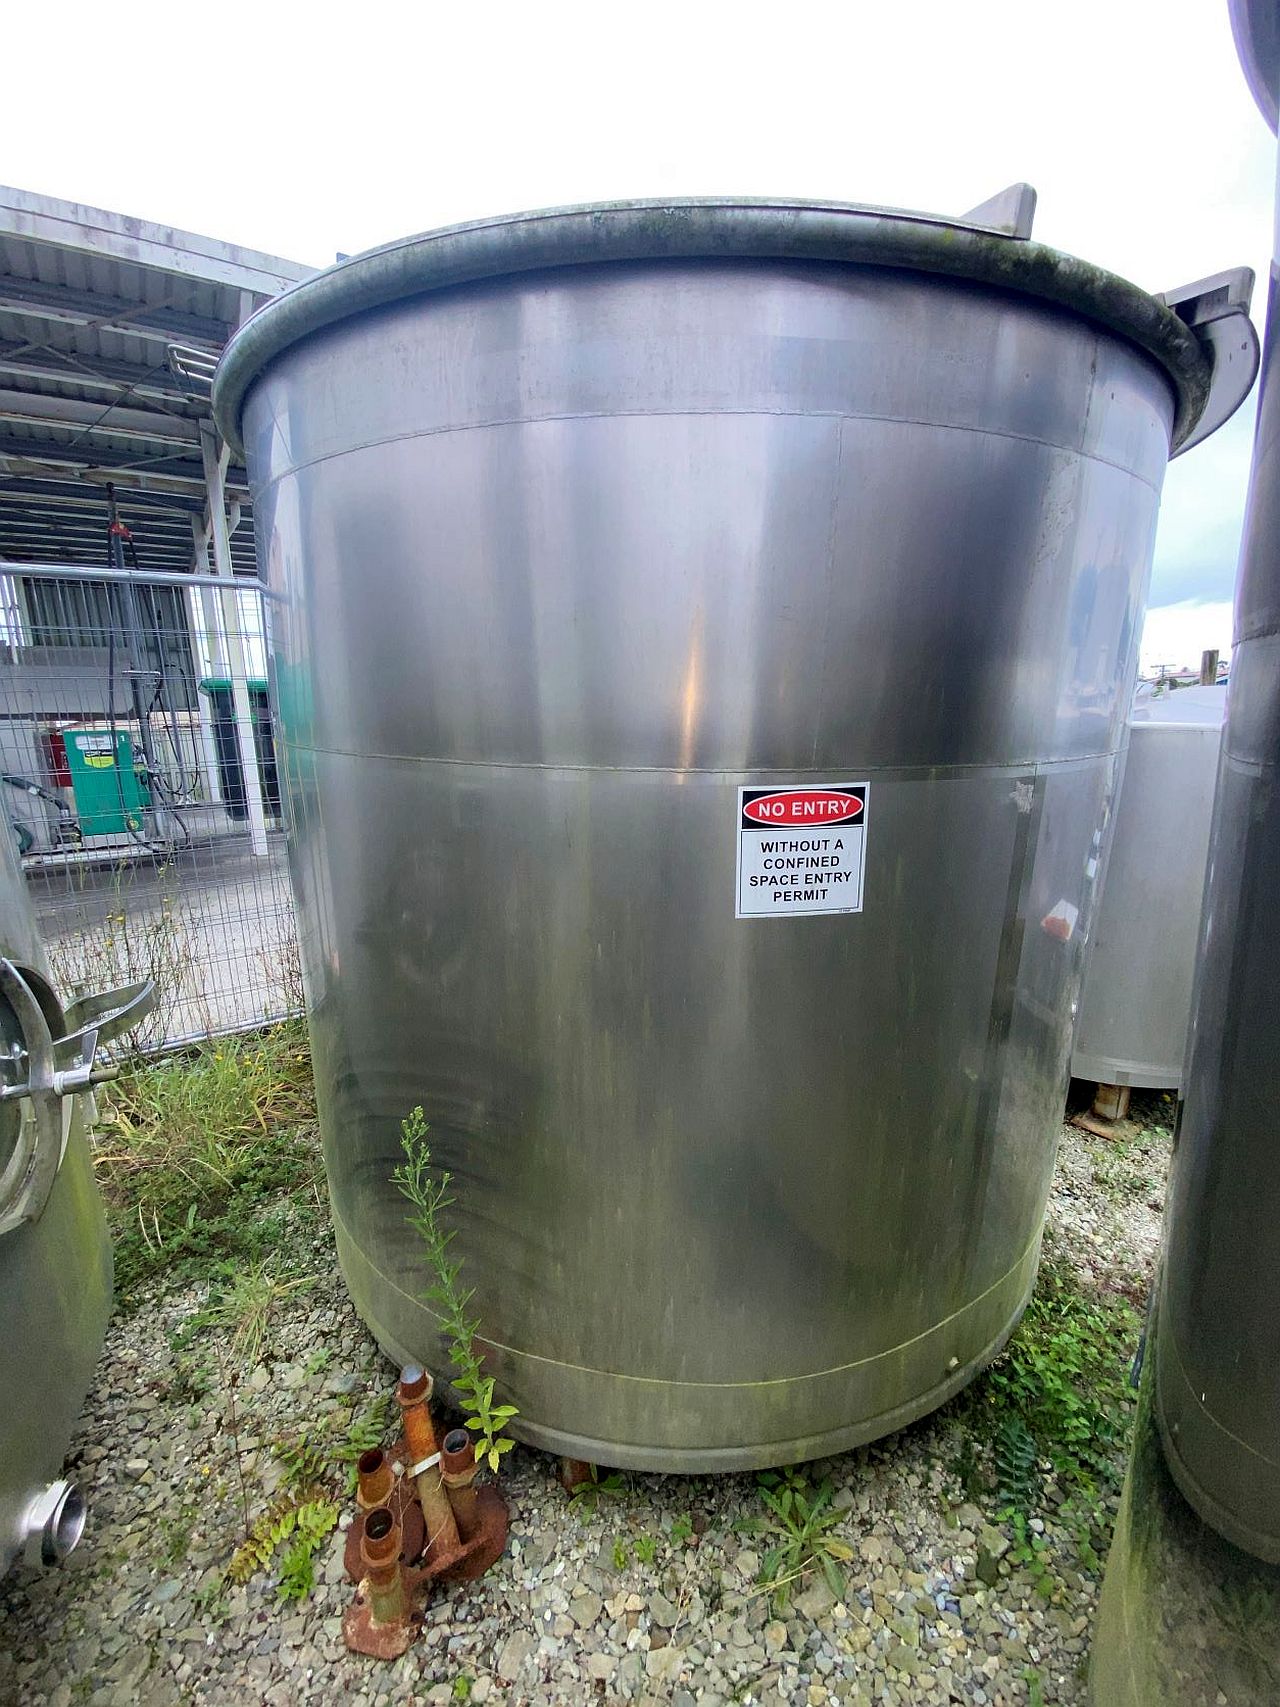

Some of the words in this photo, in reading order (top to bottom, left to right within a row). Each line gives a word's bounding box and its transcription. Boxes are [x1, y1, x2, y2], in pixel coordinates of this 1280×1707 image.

[758, 802, 785, 817] NO
[791, 799, 851, 816] ENTRY
[760, 839, 831, 853] WITHOUT
[833, 838, 844, 850] A
[763, 855, 840, 870] CONFINED
[749, 874, 799, 887] SPACE
[804, 871, 853, 885] ENTRY
[773, 888, 829, 903] PERMIT
